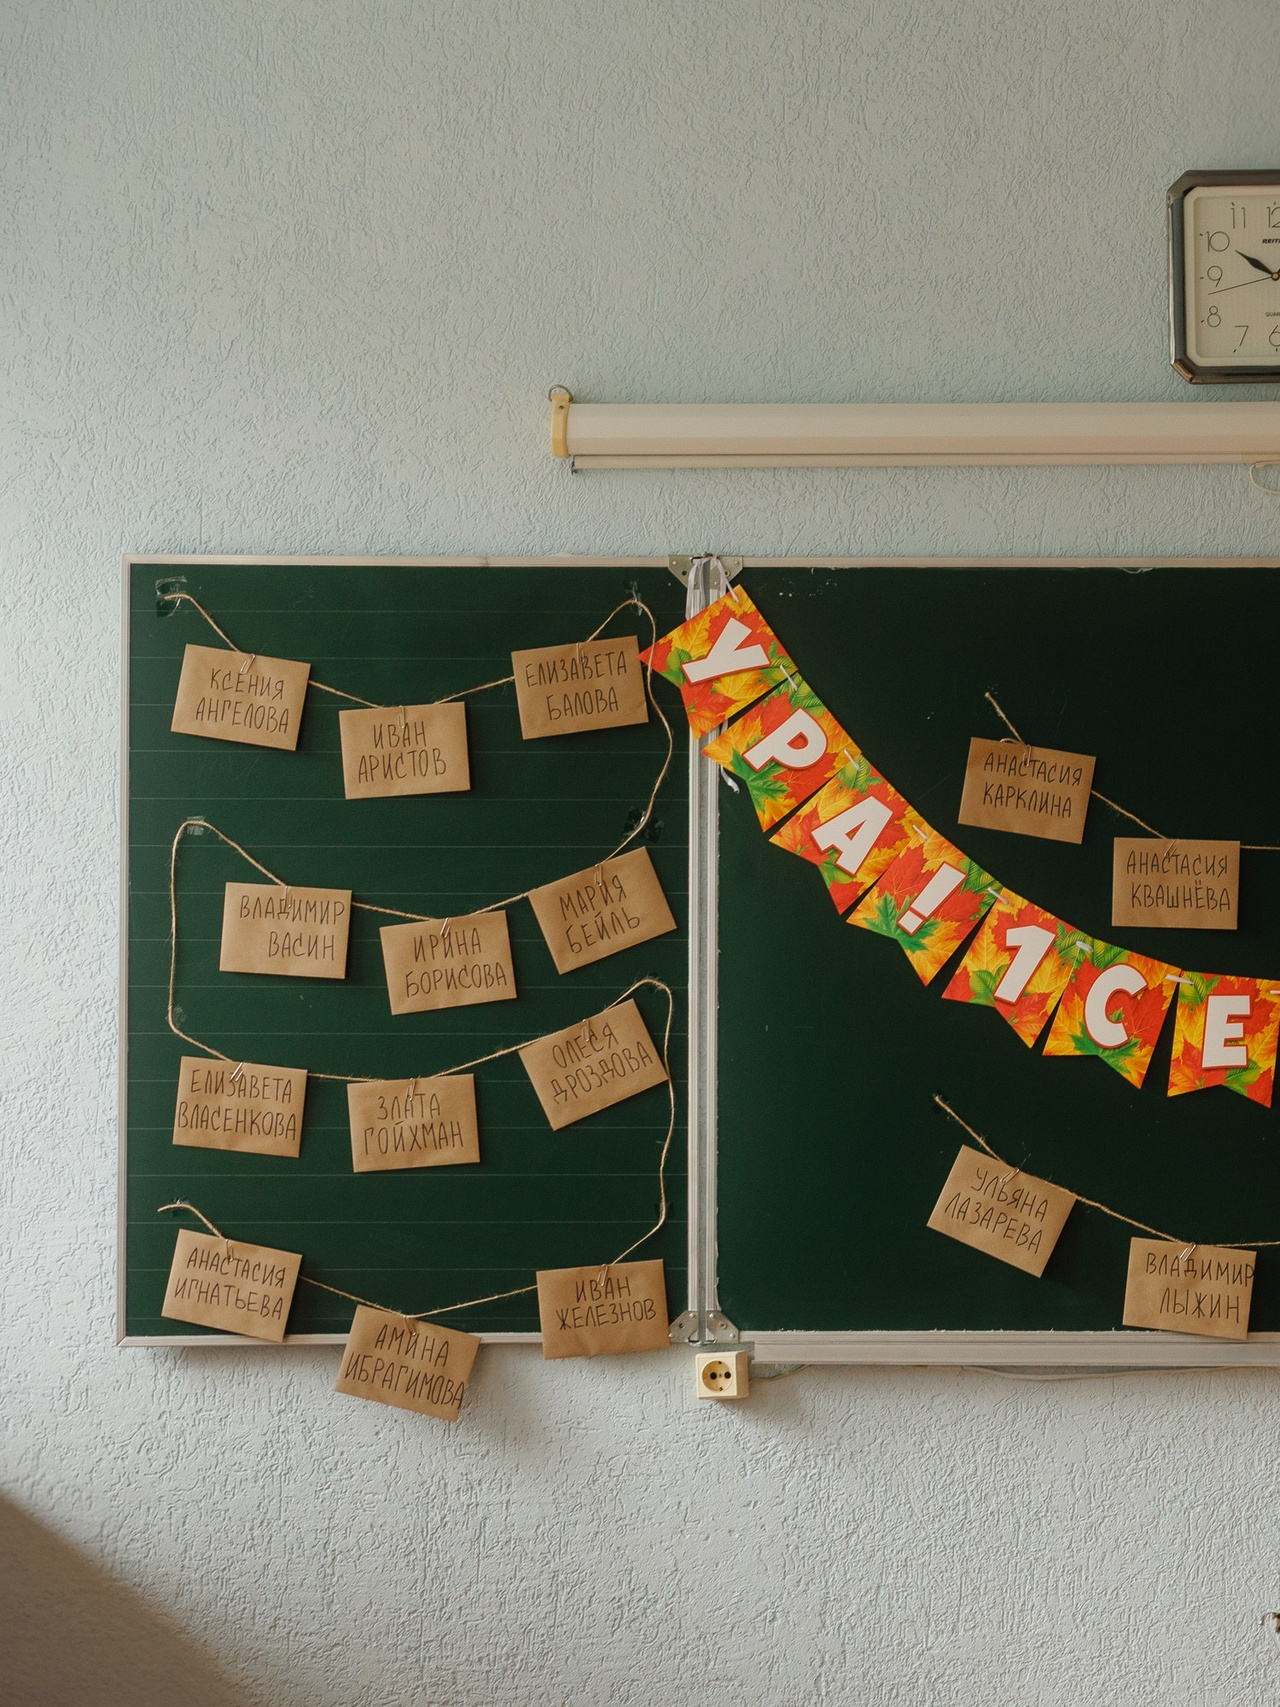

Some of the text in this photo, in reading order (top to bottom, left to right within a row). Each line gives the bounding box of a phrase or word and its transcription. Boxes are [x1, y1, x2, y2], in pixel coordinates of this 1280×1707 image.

[1231, 207, 1245, 229] 11
[1206, 231, 1230, 252] 10
[1207, 265, 1223, 288] 9
[1207, 306, 1221, 327] 8
[1235, 325, 1249, 346] 7
[210, 668, 284, 700] КСЕНИЯ
[524, 650, 627, 688] ЕЛИЗАВЕТА
[195, 696, 289, 734] АНГЕЛОВА
[546, 687, 619, 721] БАЛОВА
[373, 721, 427, 749] ИВАН
[358, 748, 446, 784] АРИСТОВ
[984, 752, 1083, 787] АНАСТАСИЯ
[682, 616, 966, 935] УРА!
[993, 925, 1057, 1004] 1
[983, 782, 1072, 819] КАРКЛИНА
[1126, 851, 1228, 876] АНАСТАСИЯ
[239, 895, 345, 922] ВЛАДИМИР
[559, 875, 627, 921] МАРИЯ
[1131, 880, 1230, 912] КВАШНЁВА
[268, 932, 335, 961] ВАСИН
[413, 927, 482, 962] ИРИНА
[566, 907, 640, 954] БЕЙЛЬ
[405, 963, 507, 998] БОРИСОВА
[552, 1021, 619, 1069] ОЛЕСЯ
[191, 1069, 292, 1103] ЕЛИЗАВЕТА
[550, 1041, 654, 1105] ДРОЗДОВА
[177, 1102, 297, 1141] ВЛАСЕНКОВА
[377, 1092, 441, 1121] ЗЛАТА
[364, 1121, 464, 1155] ГОЙХМАН
[971, 1167, 1049, 1222] УЛЬЯНА
[944, 1192, 1043, 1255] ЛАЗАРЕВА
[186, 1248, 286, 1288] АНАСТАСИЯ
[1146, 1252, 1254, 1287] ВЛАДИМИР
[174, 1277, 283, 1320] ИГНАТЬЕВА
[575, 1277, 631, 1303] ИВАН
[1159, 1288, 1240, 1324] ЛЫЖИН
[556, 1298, 656, 1332] ЖЕЛЕЗНОВ
[374, 1324, 449, 1367] АМИНА
[345, 1350, 466, 1409] ИБРАГИМОВА
